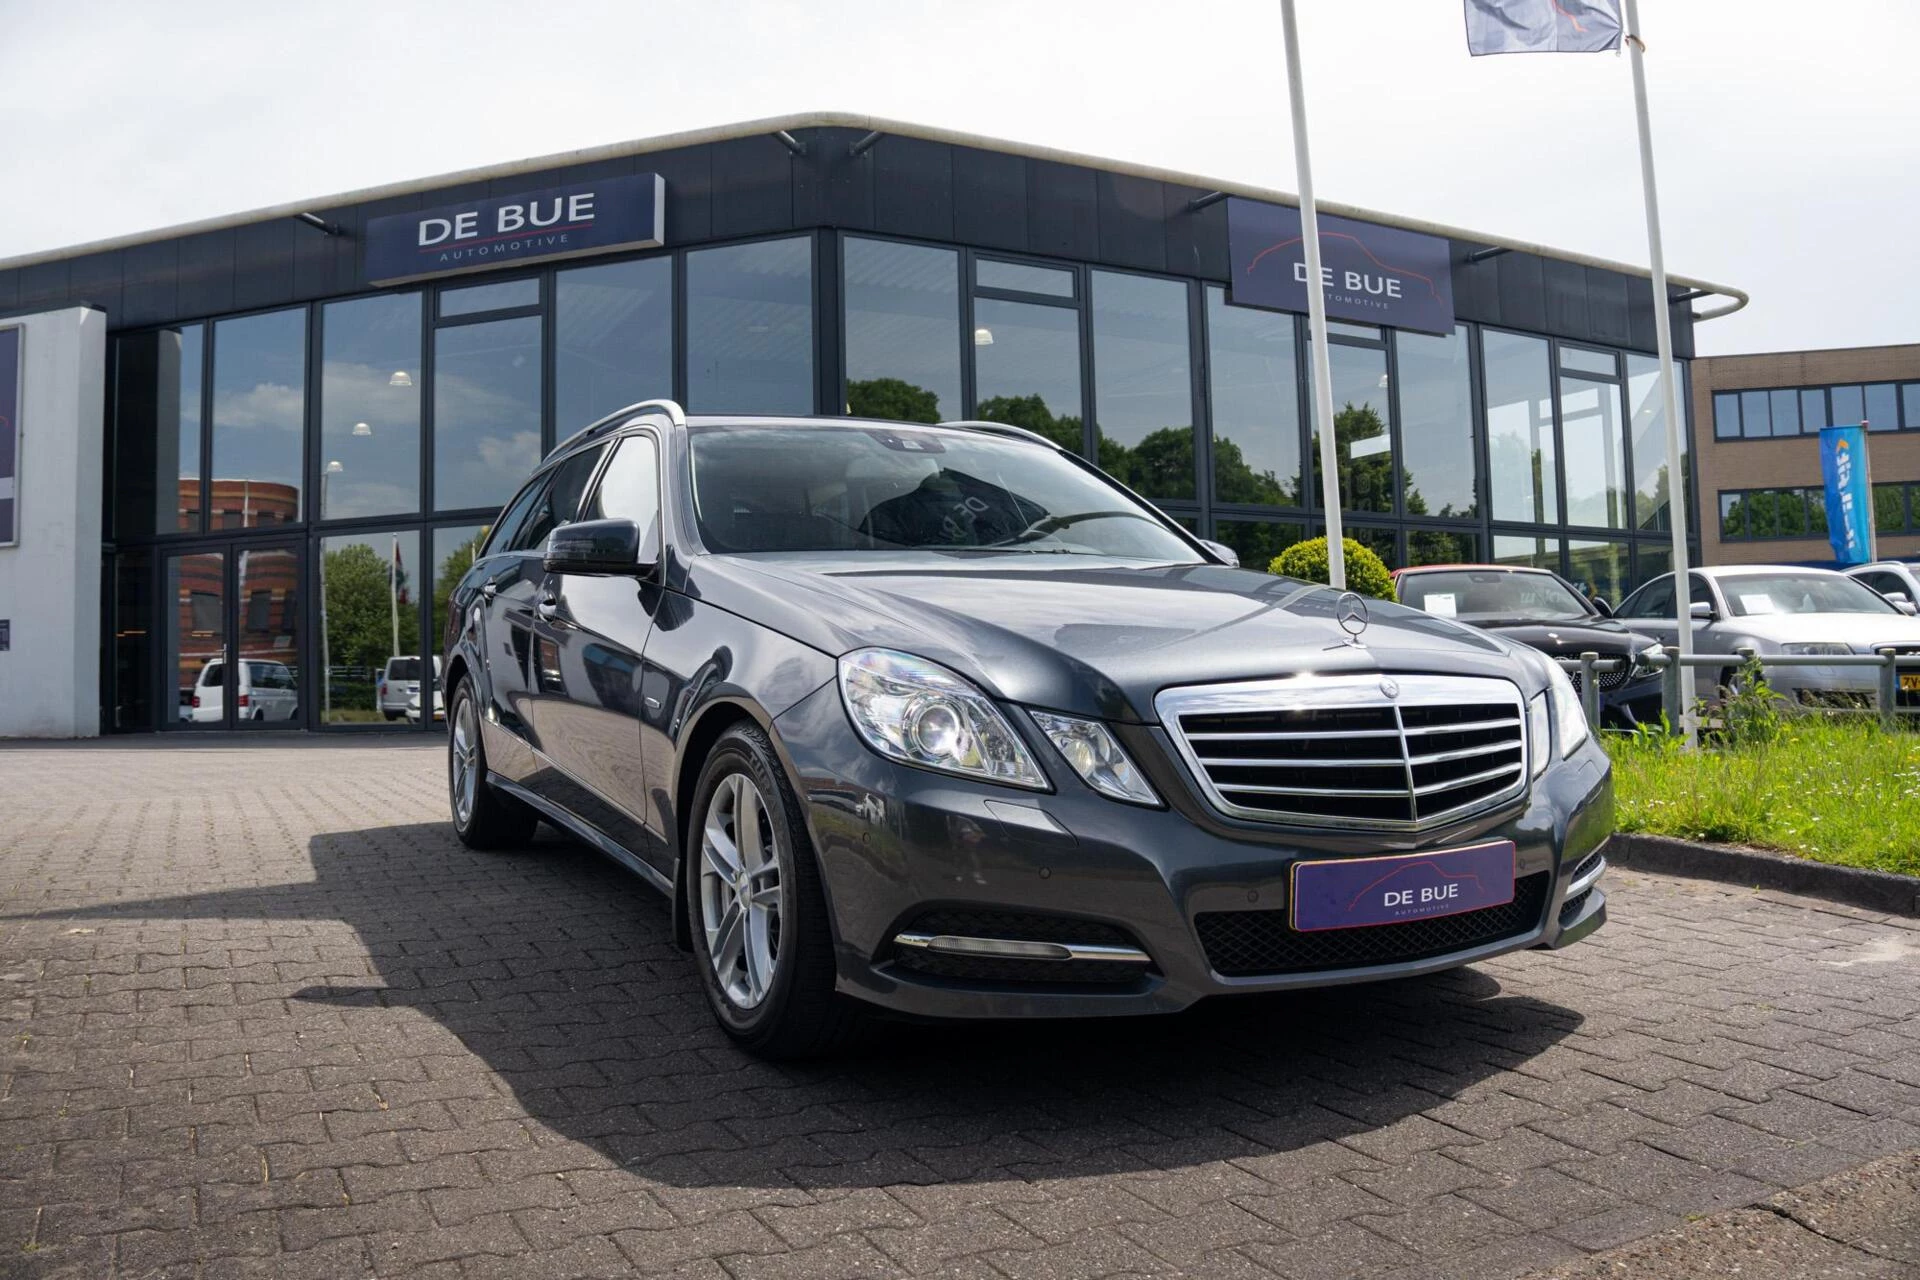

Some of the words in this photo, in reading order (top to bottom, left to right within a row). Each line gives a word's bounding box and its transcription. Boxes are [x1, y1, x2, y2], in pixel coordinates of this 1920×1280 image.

[418, 211, 478, 246] DE
[497, 193, 595, 233] BUE
[439, 233, 569, 262] AUTOMOTIVE
[1345, 271, 1402, 298] BUE
[1324, 293, 1389, 310] TOMOTIVE
[1384, 890, 1413, 907] DE
[1421, 883, 1458, 902] BUE
